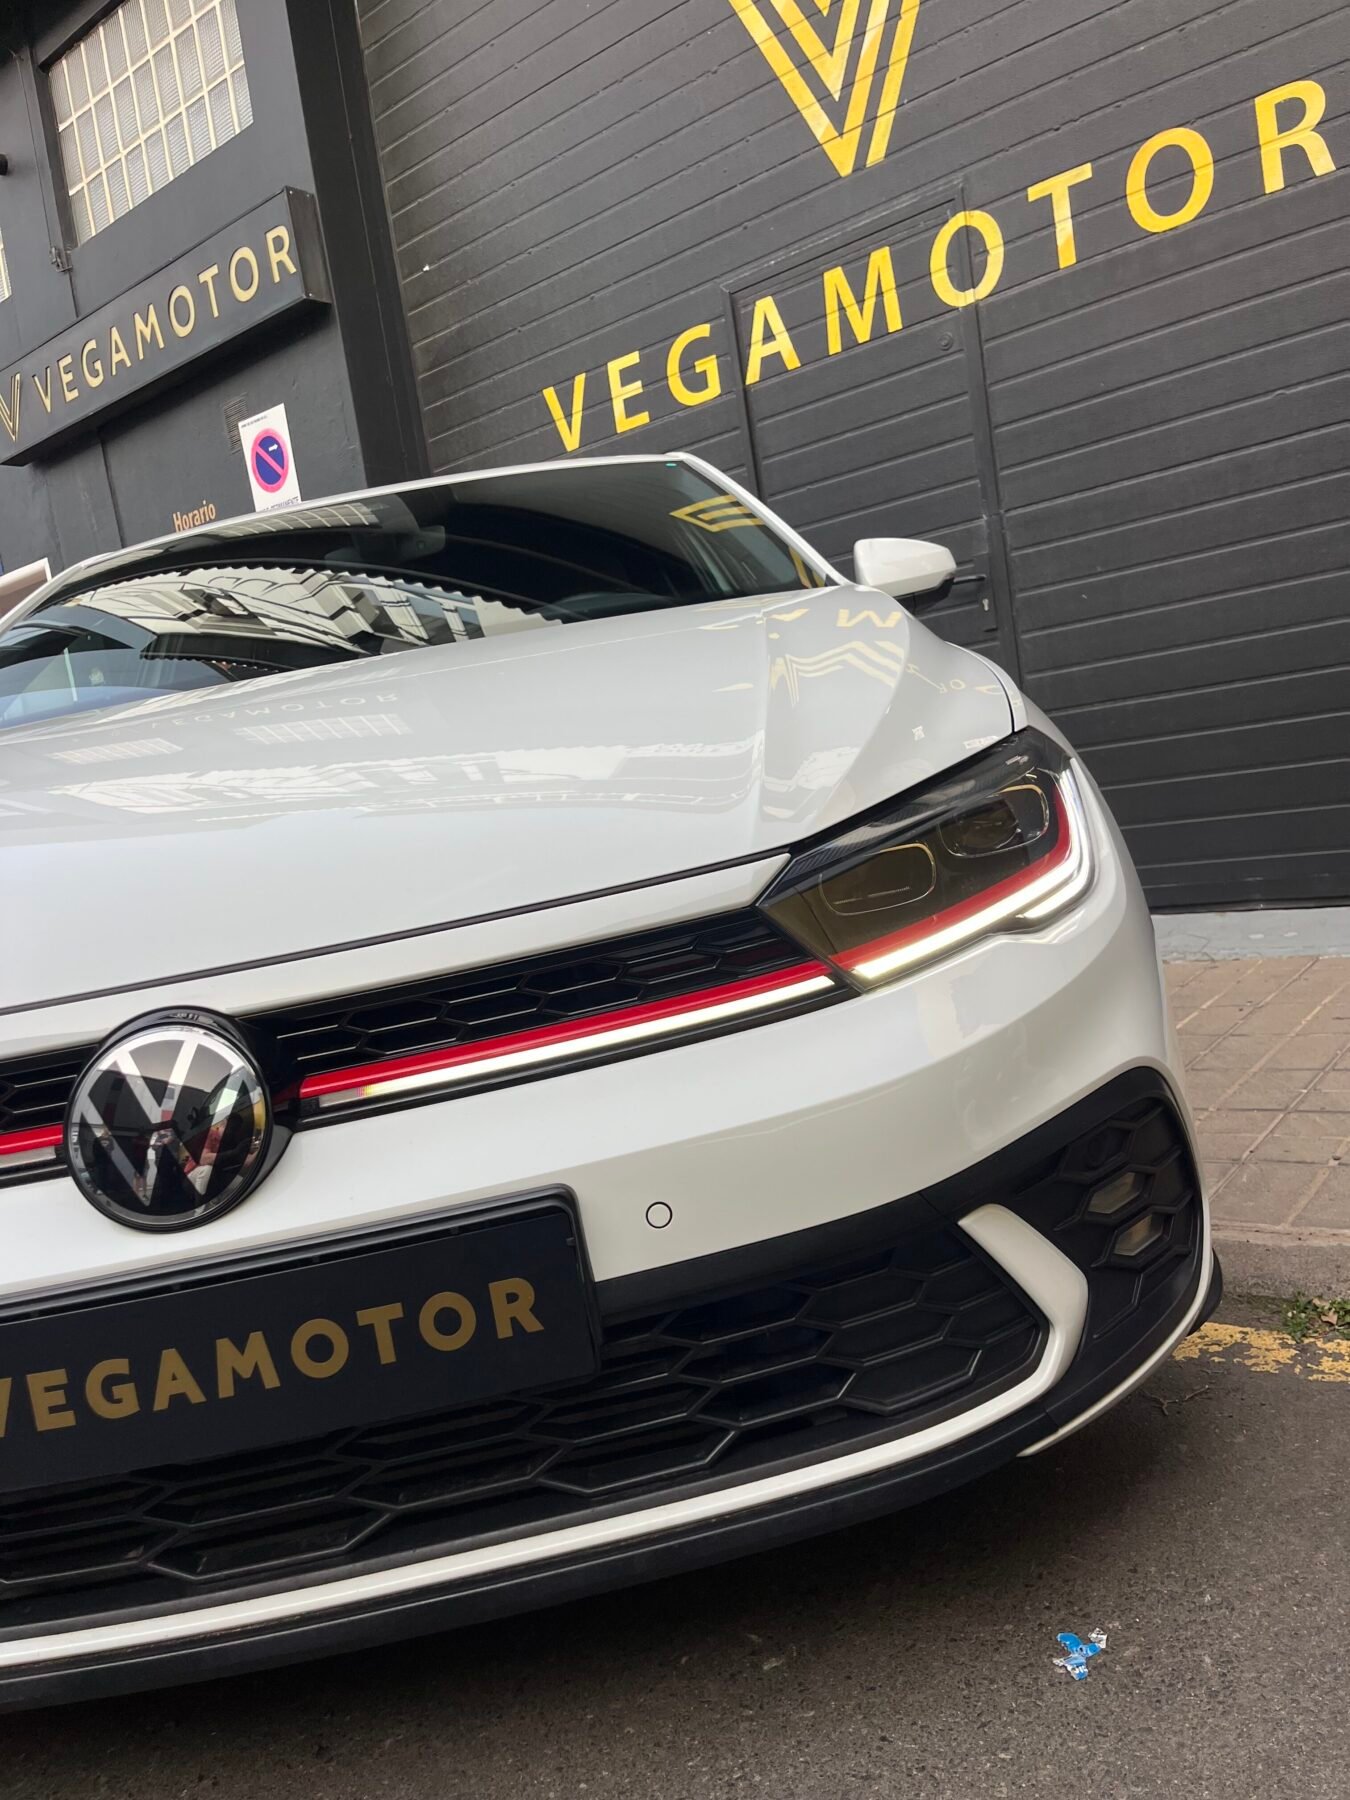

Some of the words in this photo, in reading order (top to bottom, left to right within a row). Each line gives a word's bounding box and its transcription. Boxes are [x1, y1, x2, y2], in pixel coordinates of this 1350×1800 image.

[32, 225, 297, 413] VEGAMOTOR
[544, 79, 1336, 452] VEGAMOTOR
[173, 499, 217, 533] Horario
